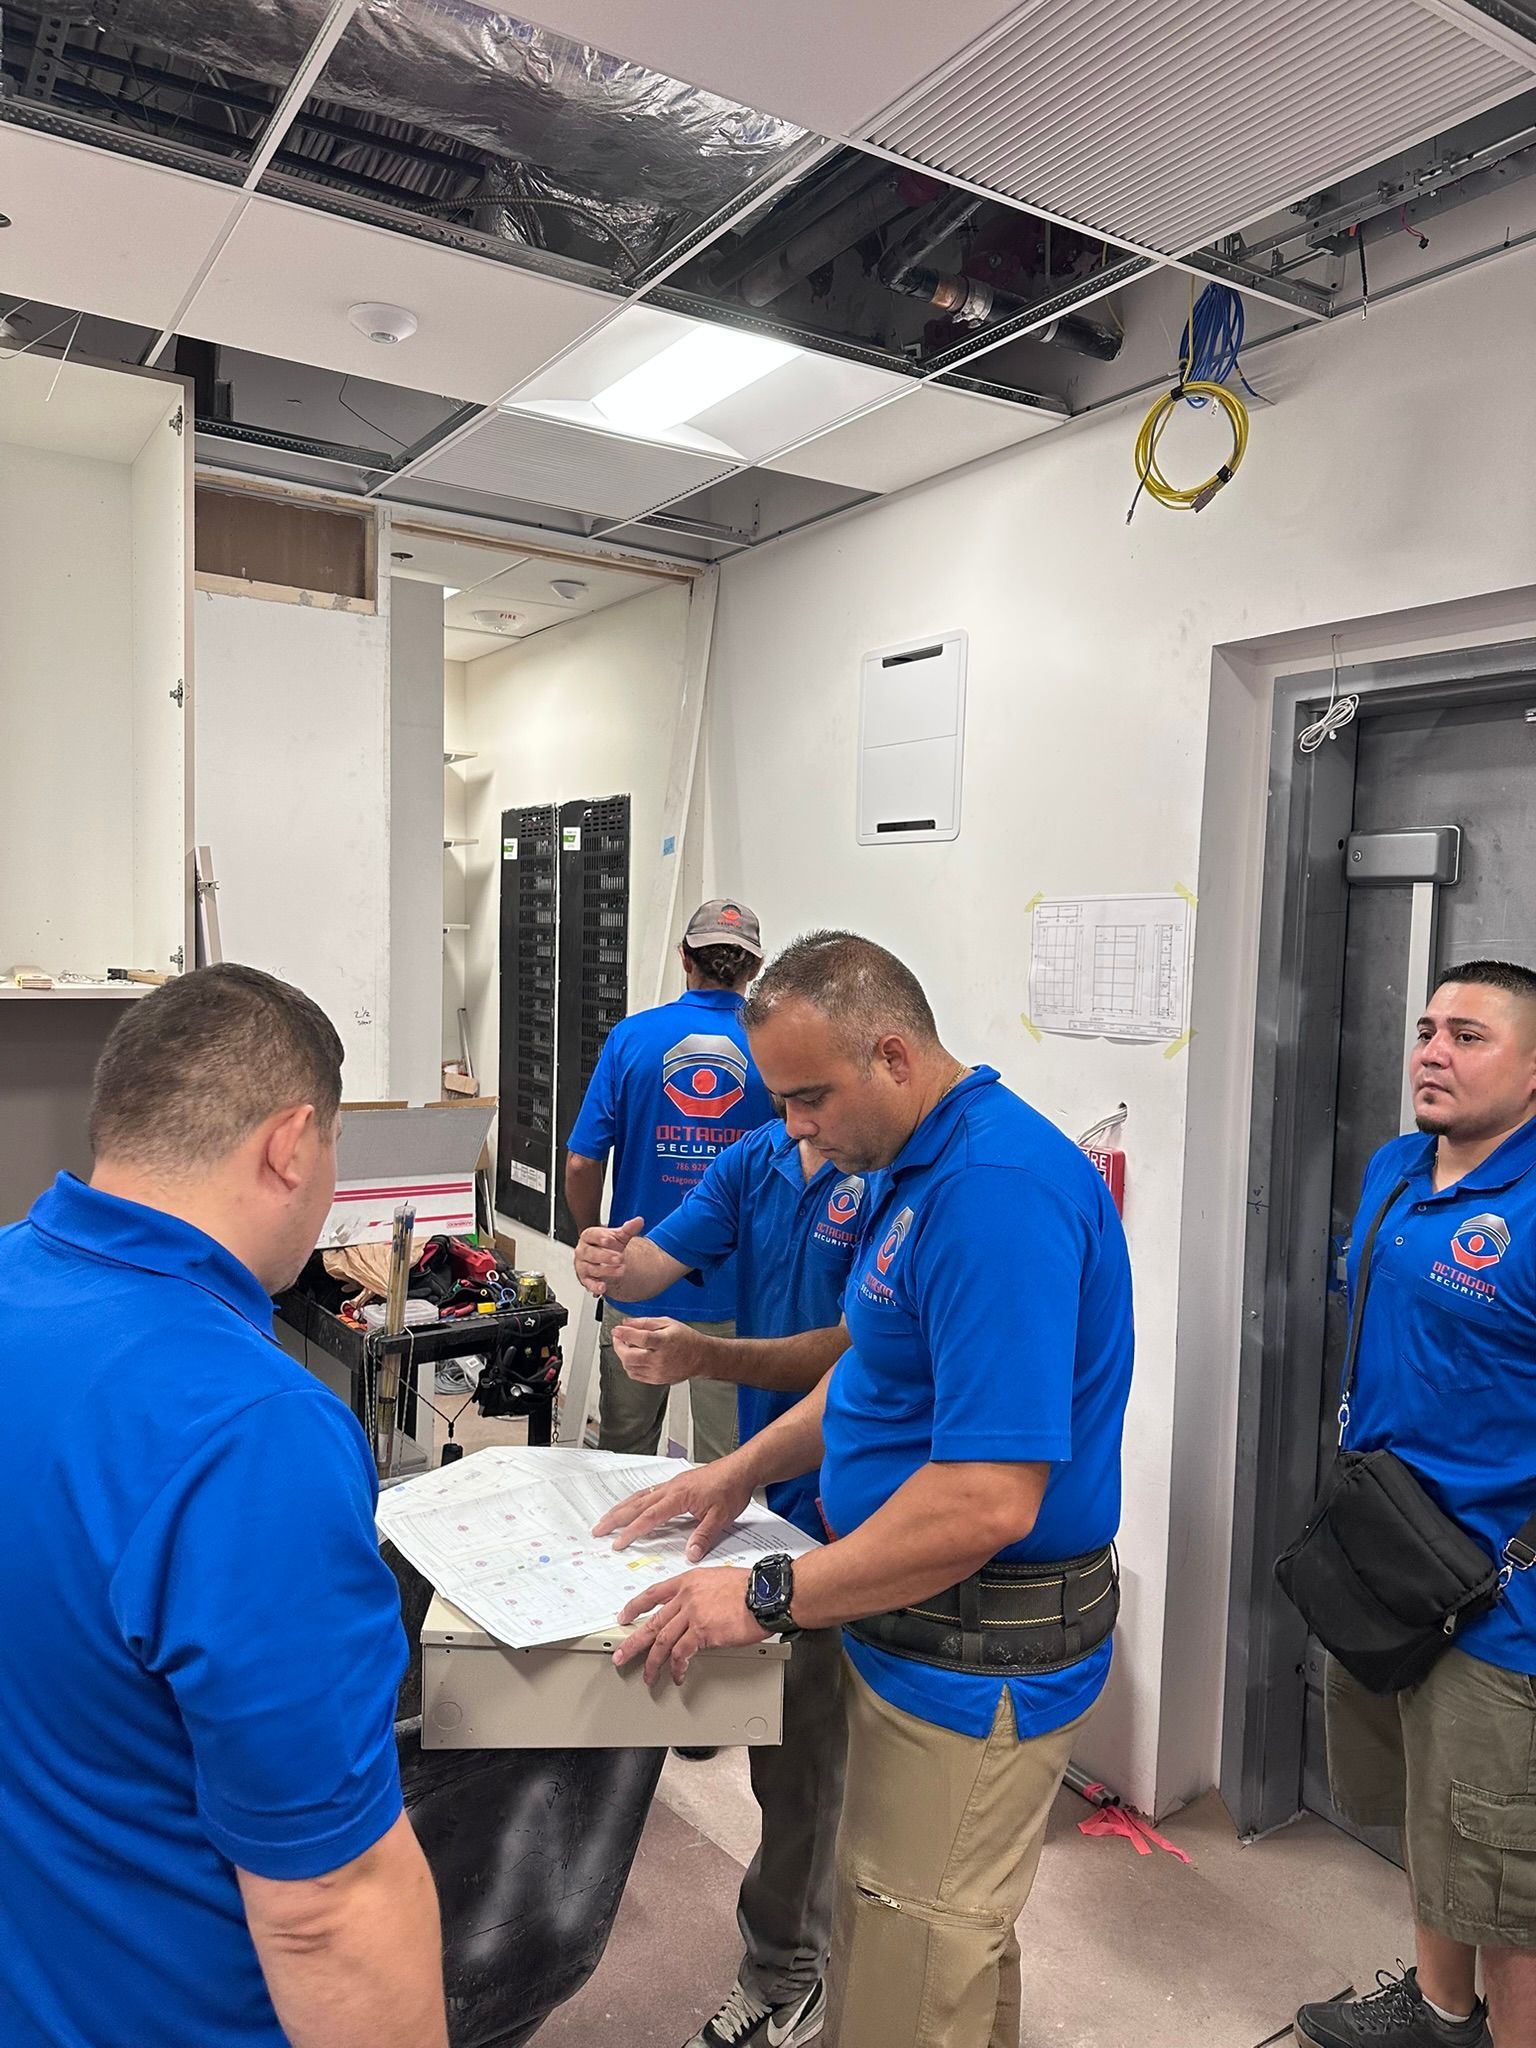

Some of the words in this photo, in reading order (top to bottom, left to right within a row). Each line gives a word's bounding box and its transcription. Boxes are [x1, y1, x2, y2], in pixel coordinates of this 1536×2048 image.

[500, 613, 517, 621] FIRE
[656, 1143, 725, 1154] SECURI
[676, 1162, 708, 1171] 786.928
[1087, 1151, 1108, 1170] RE
[662, 1174, 702, 1185] Octagons
[813, 1231, 857, 1249] SECURITY
[1432, 1261, 1496, 1295] OCTAGON
[860, 1283, 897, 1307] SECURITY
[1429, 1272, 1495, 1303] SECURITY
